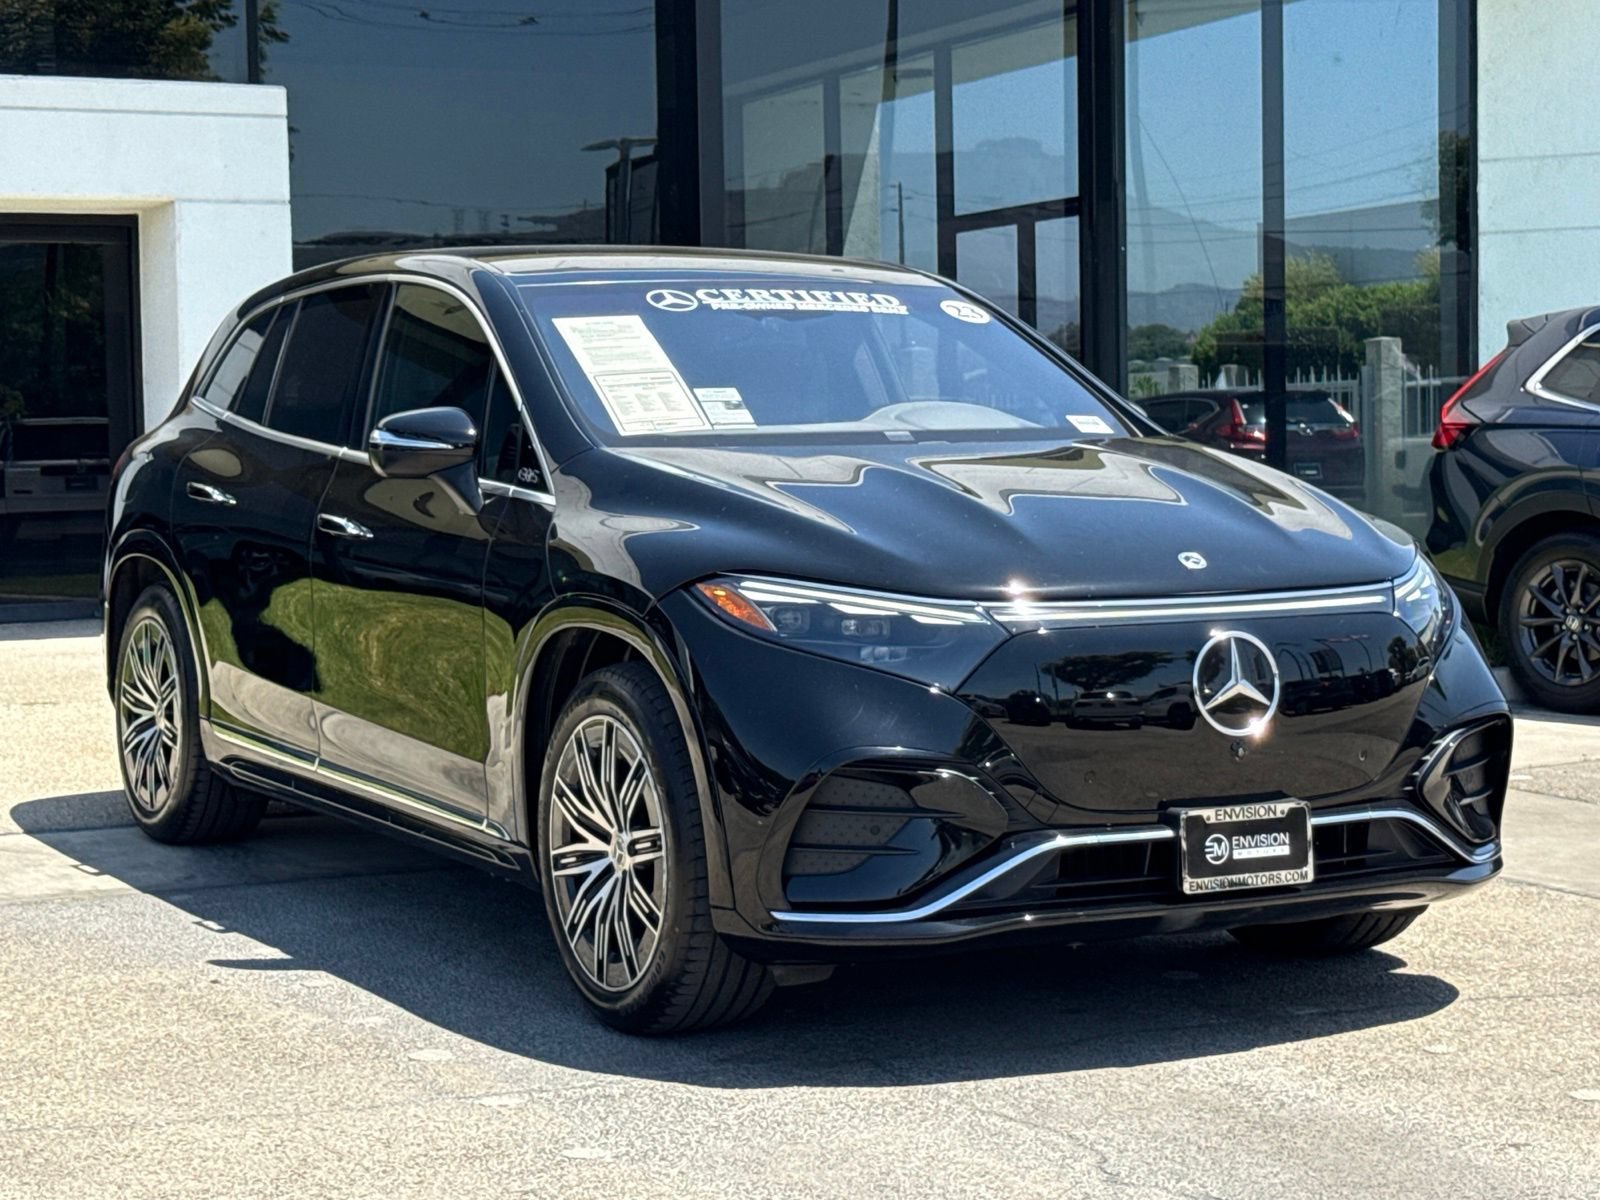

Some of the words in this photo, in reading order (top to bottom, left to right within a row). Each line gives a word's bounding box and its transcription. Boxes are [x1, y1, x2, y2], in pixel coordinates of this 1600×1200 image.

[696, 289, 900, 306] CERTIFIED
[1215, 805, 1277, 820] ENVISION
[1233, 832, 1289, 849] ENVISION
[1188, 870, 1308, 892] ENVISIONMOTORS.COM
